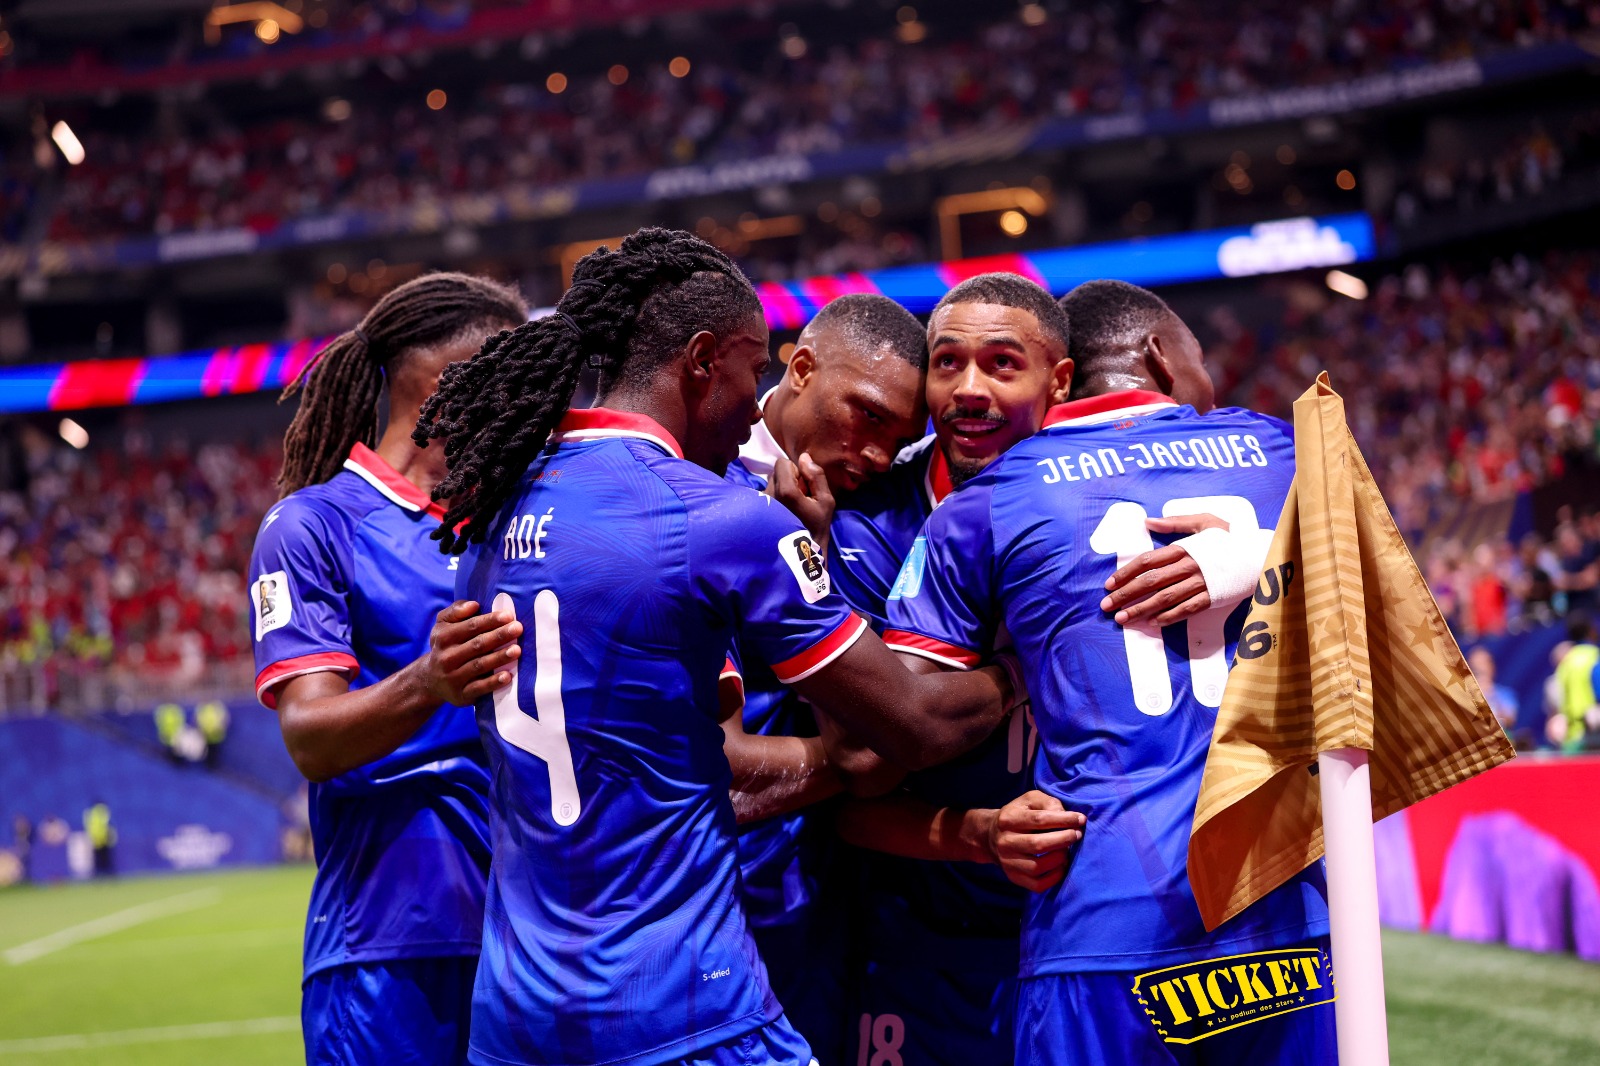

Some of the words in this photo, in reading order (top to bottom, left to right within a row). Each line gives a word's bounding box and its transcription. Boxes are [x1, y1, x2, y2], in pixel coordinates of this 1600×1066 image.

[1036, 434, 1268, 484] JEAN-JACQUES
[503, 506, 555, 561] ADÉ
[1249, 560, 1295, 612] UP
[491, 589, 581, 826] 4
[702, 966, 731, 981] S-dried
[857, 1012, 905, 1066] 18
